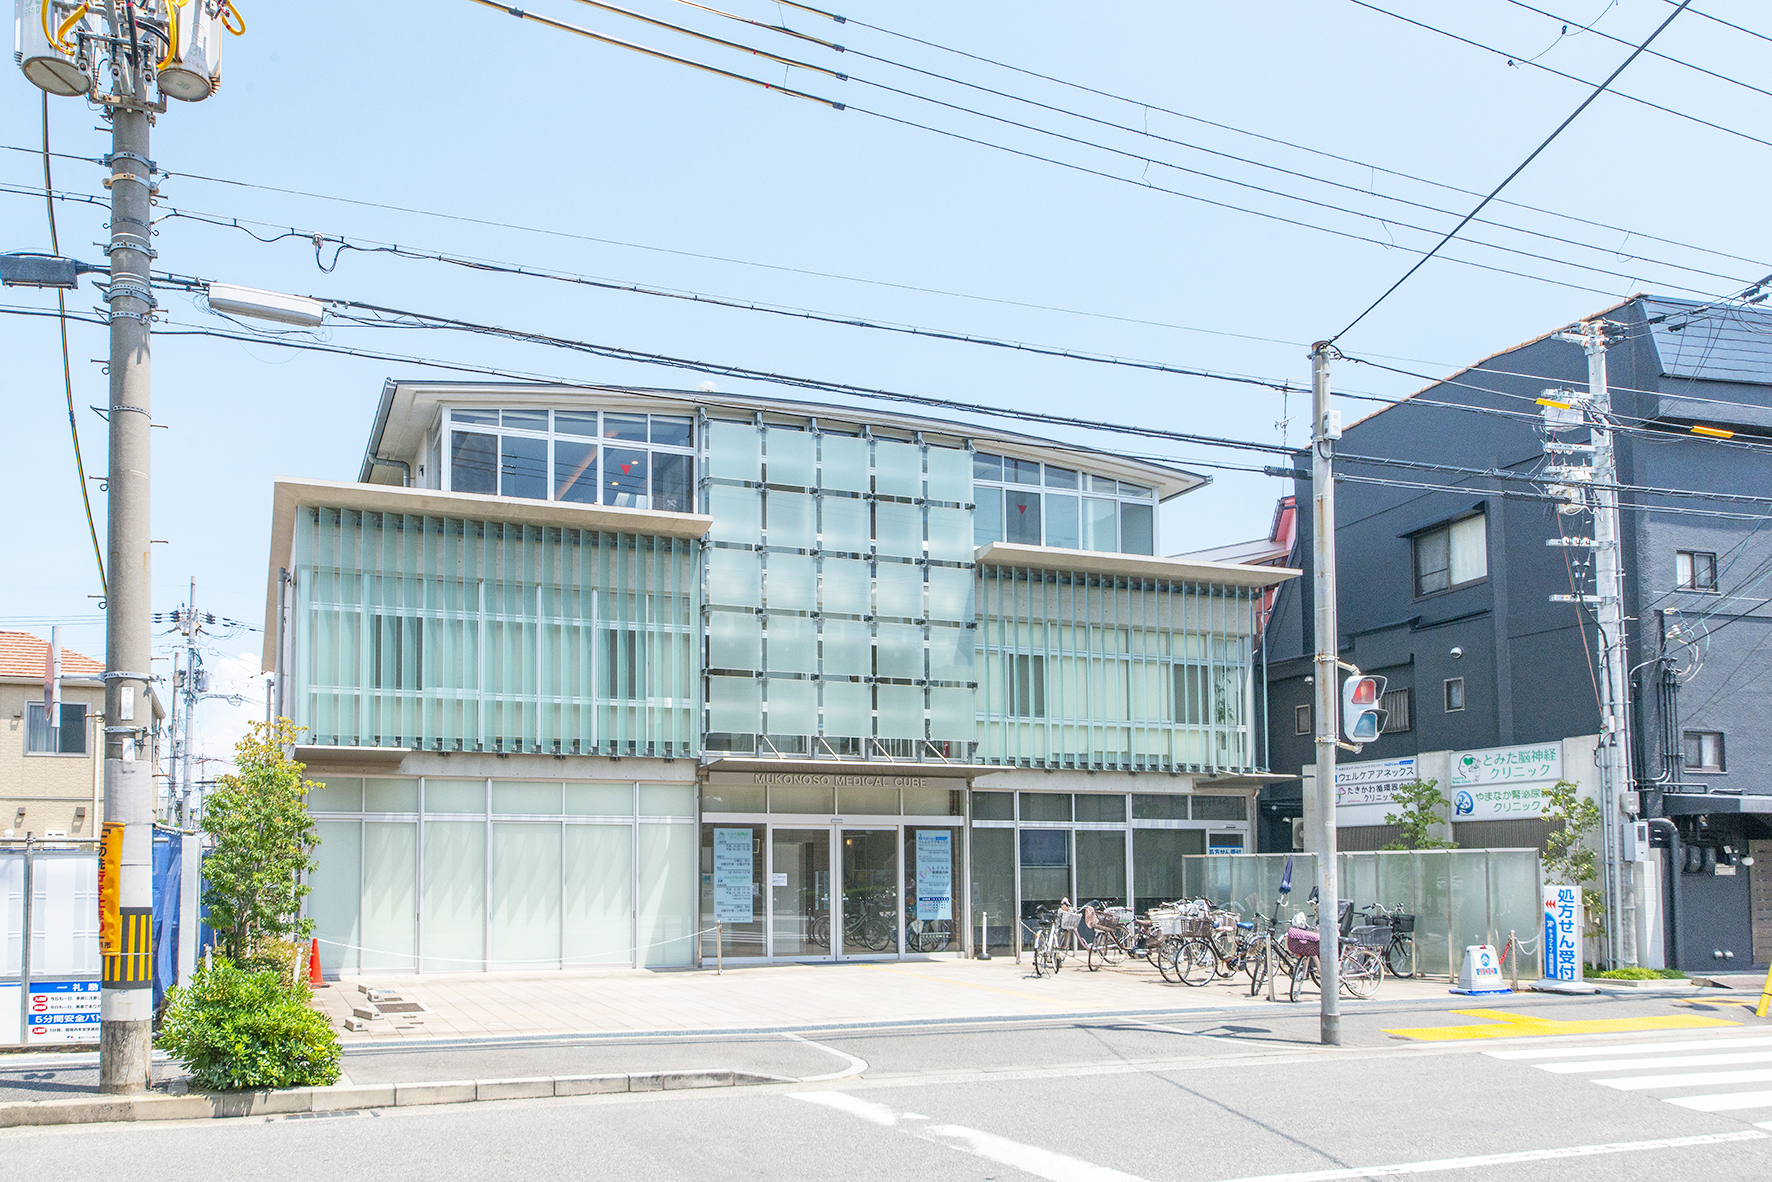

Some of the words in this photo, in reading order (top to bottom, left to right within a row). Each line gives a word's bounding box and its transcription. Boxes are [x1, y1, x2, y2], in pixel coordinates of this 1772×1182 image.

[1483, 748, 1557, 767] とみた脳神経
[1338, 766, 1415, 782] ウェルケアアネックス
[1490, 764, 1550, 780] クリニック
[754, 773, 830, 785] MUKONOSO
[835, 775, 889, 787] MEDICAL
[894, 777, 927, 788] CUBE
[1475, 788, 1556, 801] やまなか腎泌尿
[1493, 801, 1541, 813] クリニック
[1558, 888, 1576, 980] 処方せん受付
